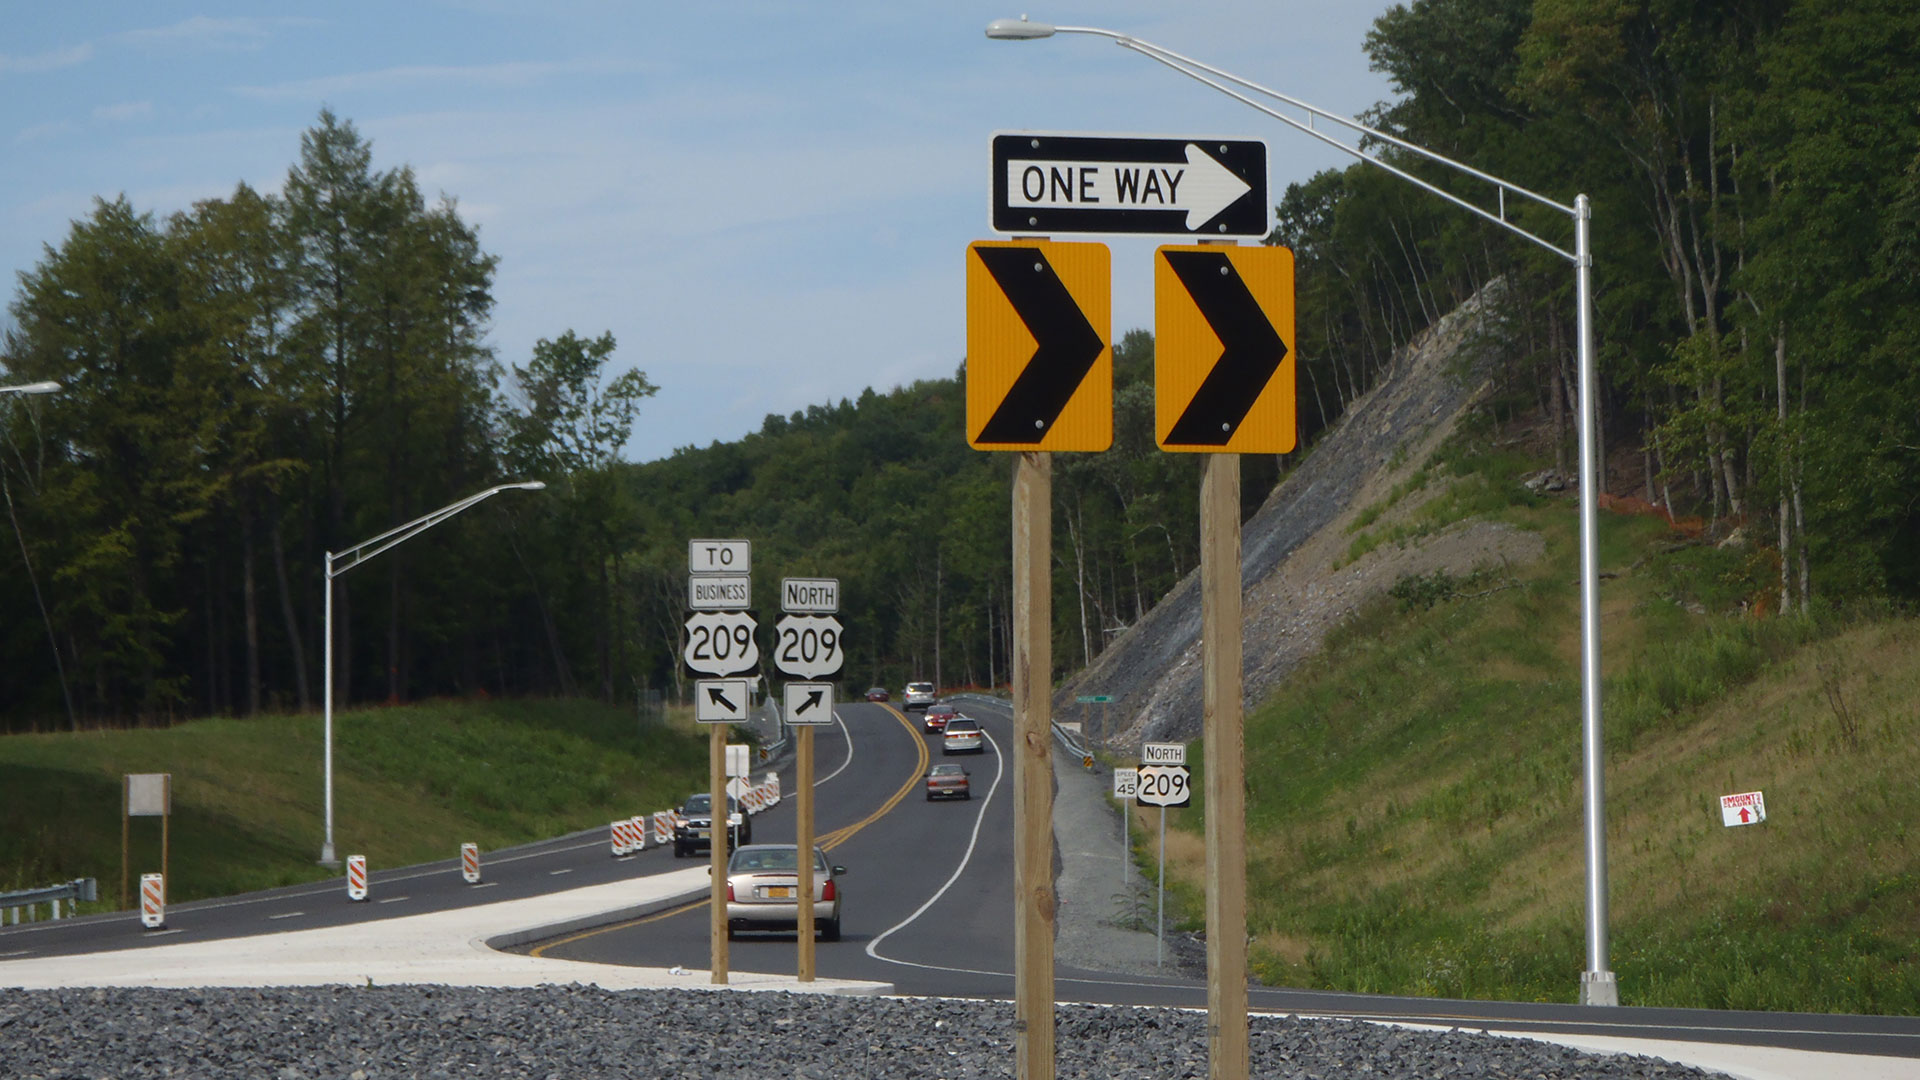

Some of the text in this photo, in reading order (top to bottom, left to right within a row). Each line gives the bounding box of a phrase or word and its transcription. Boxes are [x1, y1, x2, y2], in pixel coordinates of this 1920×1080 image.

[1022, 165, 1185, 204] ONE WAY
[706, 547, 733, 565] TO
[696, 584, 746, 600] BUSINESS
[788, 584, 834, 605] NORTH
[693, 625, 750, 660] 209
[782, 628, 836, 663] 209
[1146, 746, 1182, 760] NORTH
[1117, 784, 1136, 795] 45
[1143, 774, 1184, 796] 209
[1727, 793, 1756, 803] MOUNT
